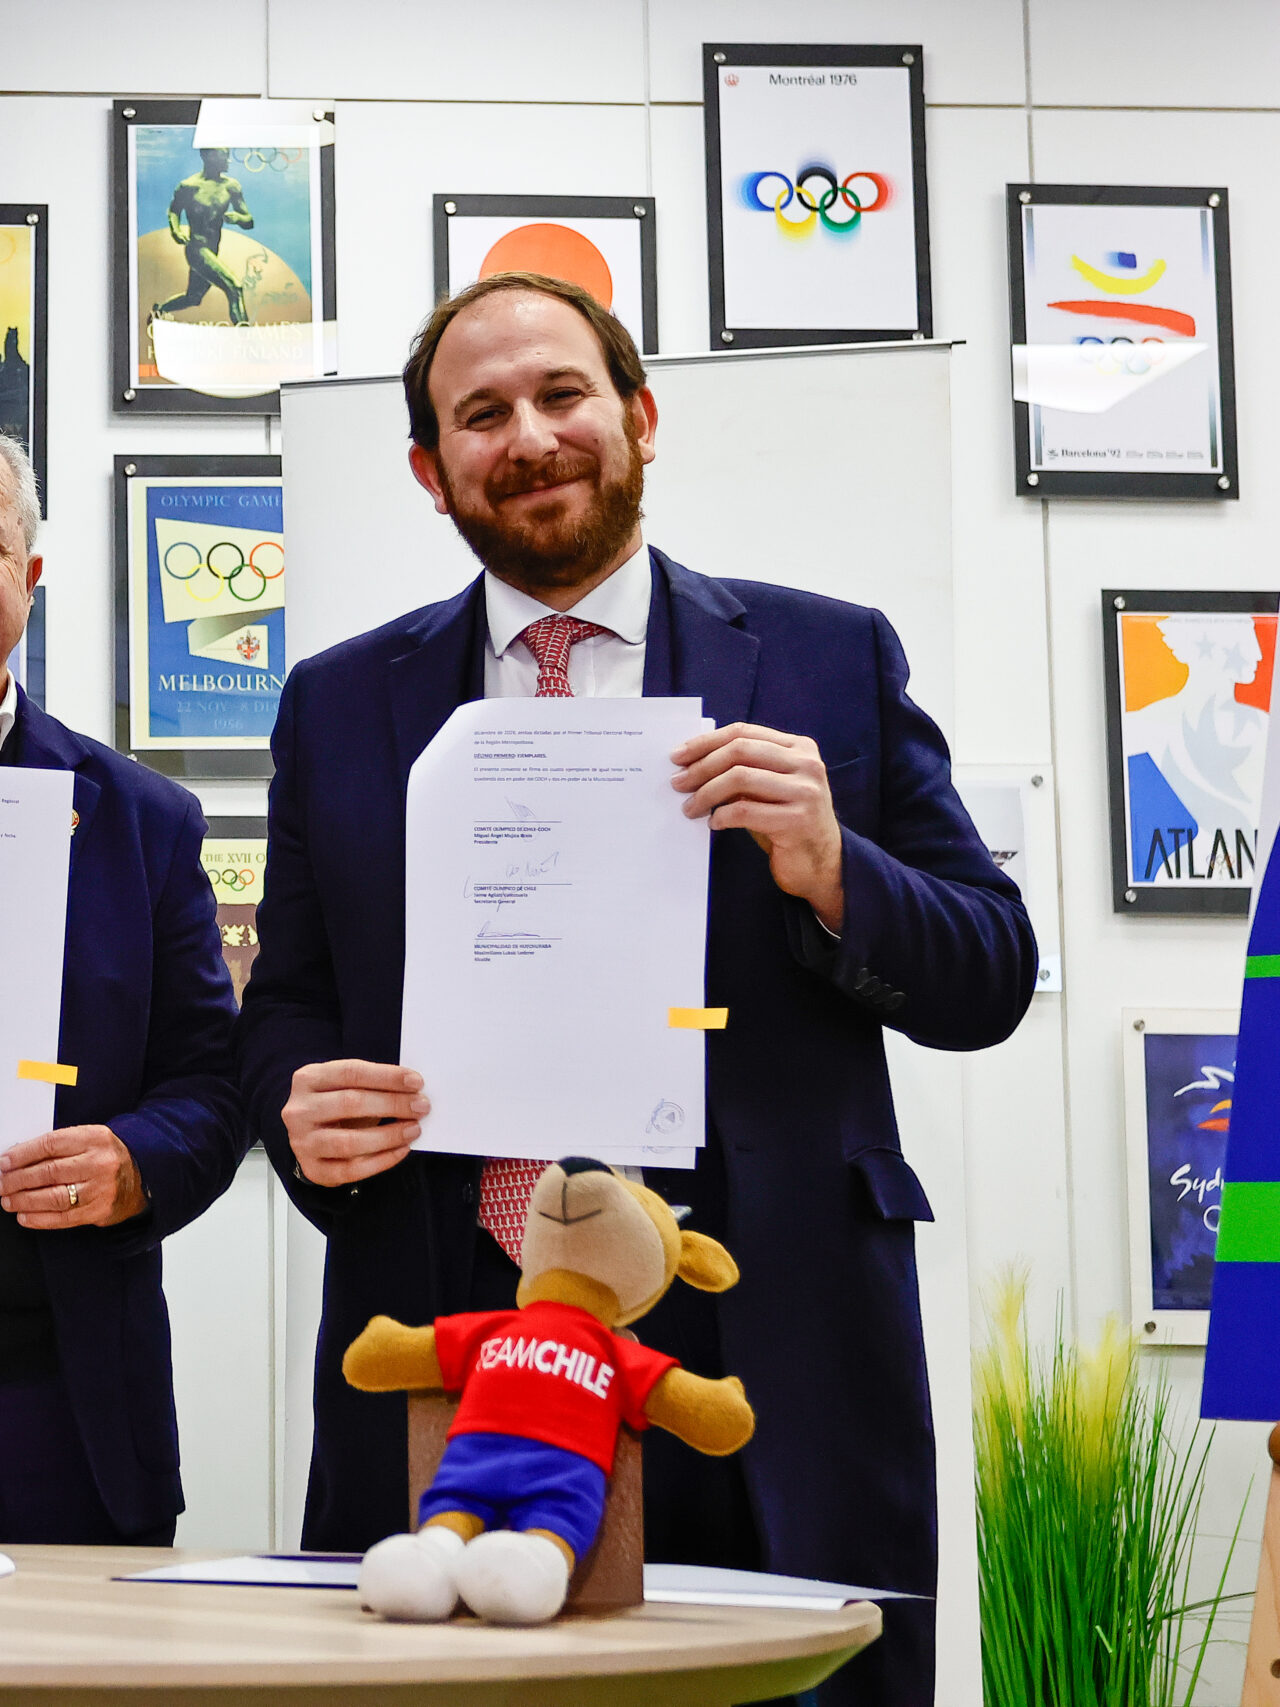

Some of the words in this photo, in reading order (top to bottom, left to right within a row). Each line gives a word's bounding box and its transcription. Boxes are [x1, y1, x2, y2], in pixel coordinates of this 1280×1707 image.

[769, 73, 825, 86] Montréal
[830, 74, 857, 86] 1976
[160, 494, 231, 507] OLYMPIC
[204, 854, 224, 863] THE
[227, 853, 251, 864] XVII
